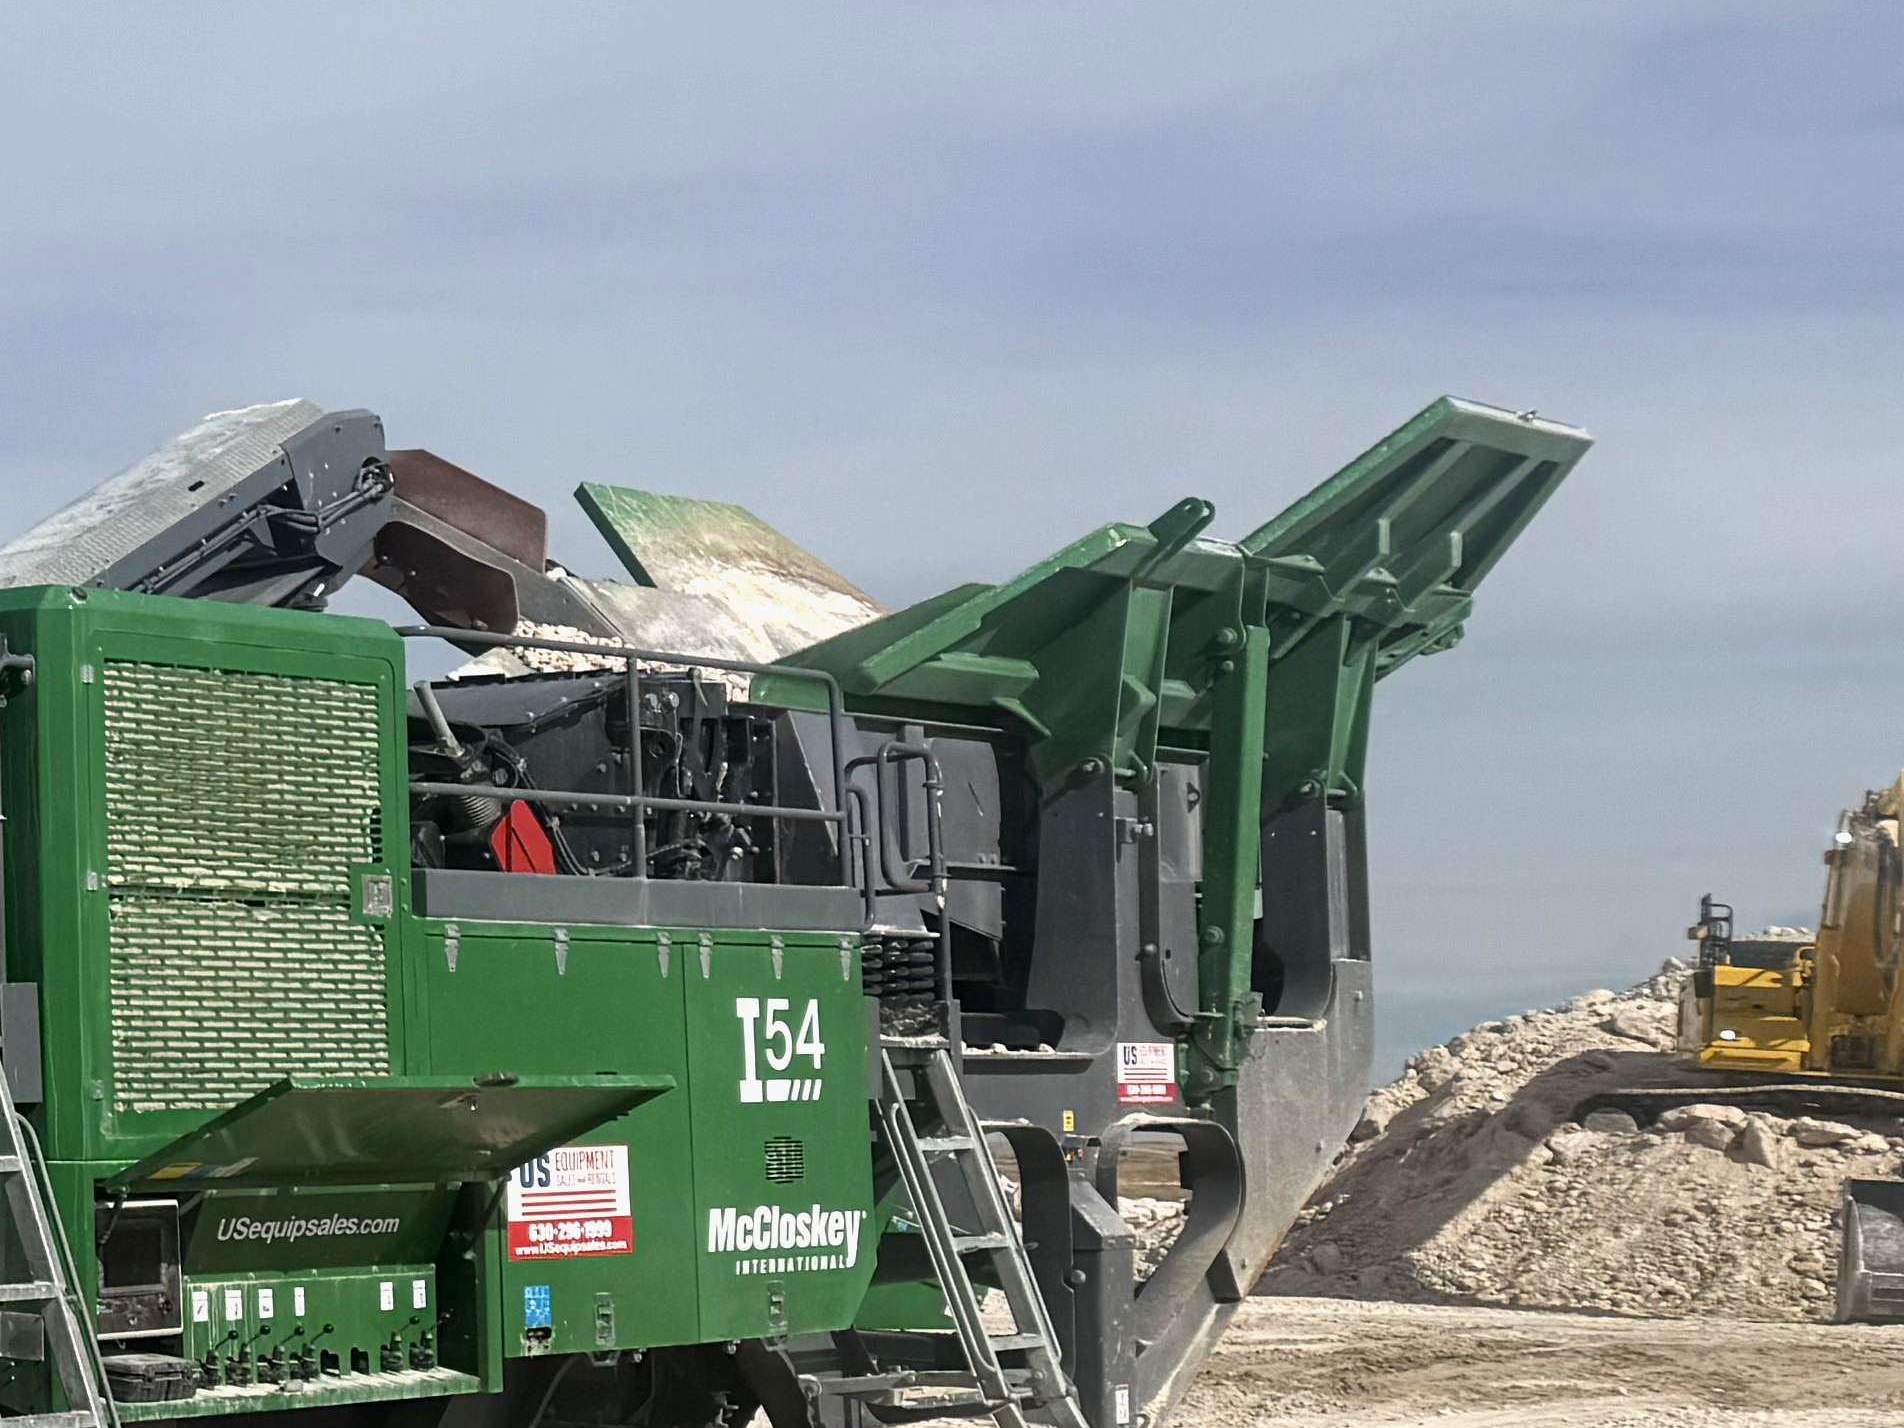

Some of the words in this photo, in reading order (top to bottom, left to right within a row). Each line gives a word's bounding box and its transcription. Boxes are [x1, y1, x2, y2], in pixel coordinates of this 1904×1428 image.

[1123, 1045, 1138, 1065] US
[519, 1154, 551, 1188] US
[555, 1149, 616, 1172] EQUIPMENT
[217, 1213, 400, 1244] USequipsales.com
[707, 1204, 862, 1268] McCloskey
[736, 1254, 846, 1275] INTERNATIONAL
